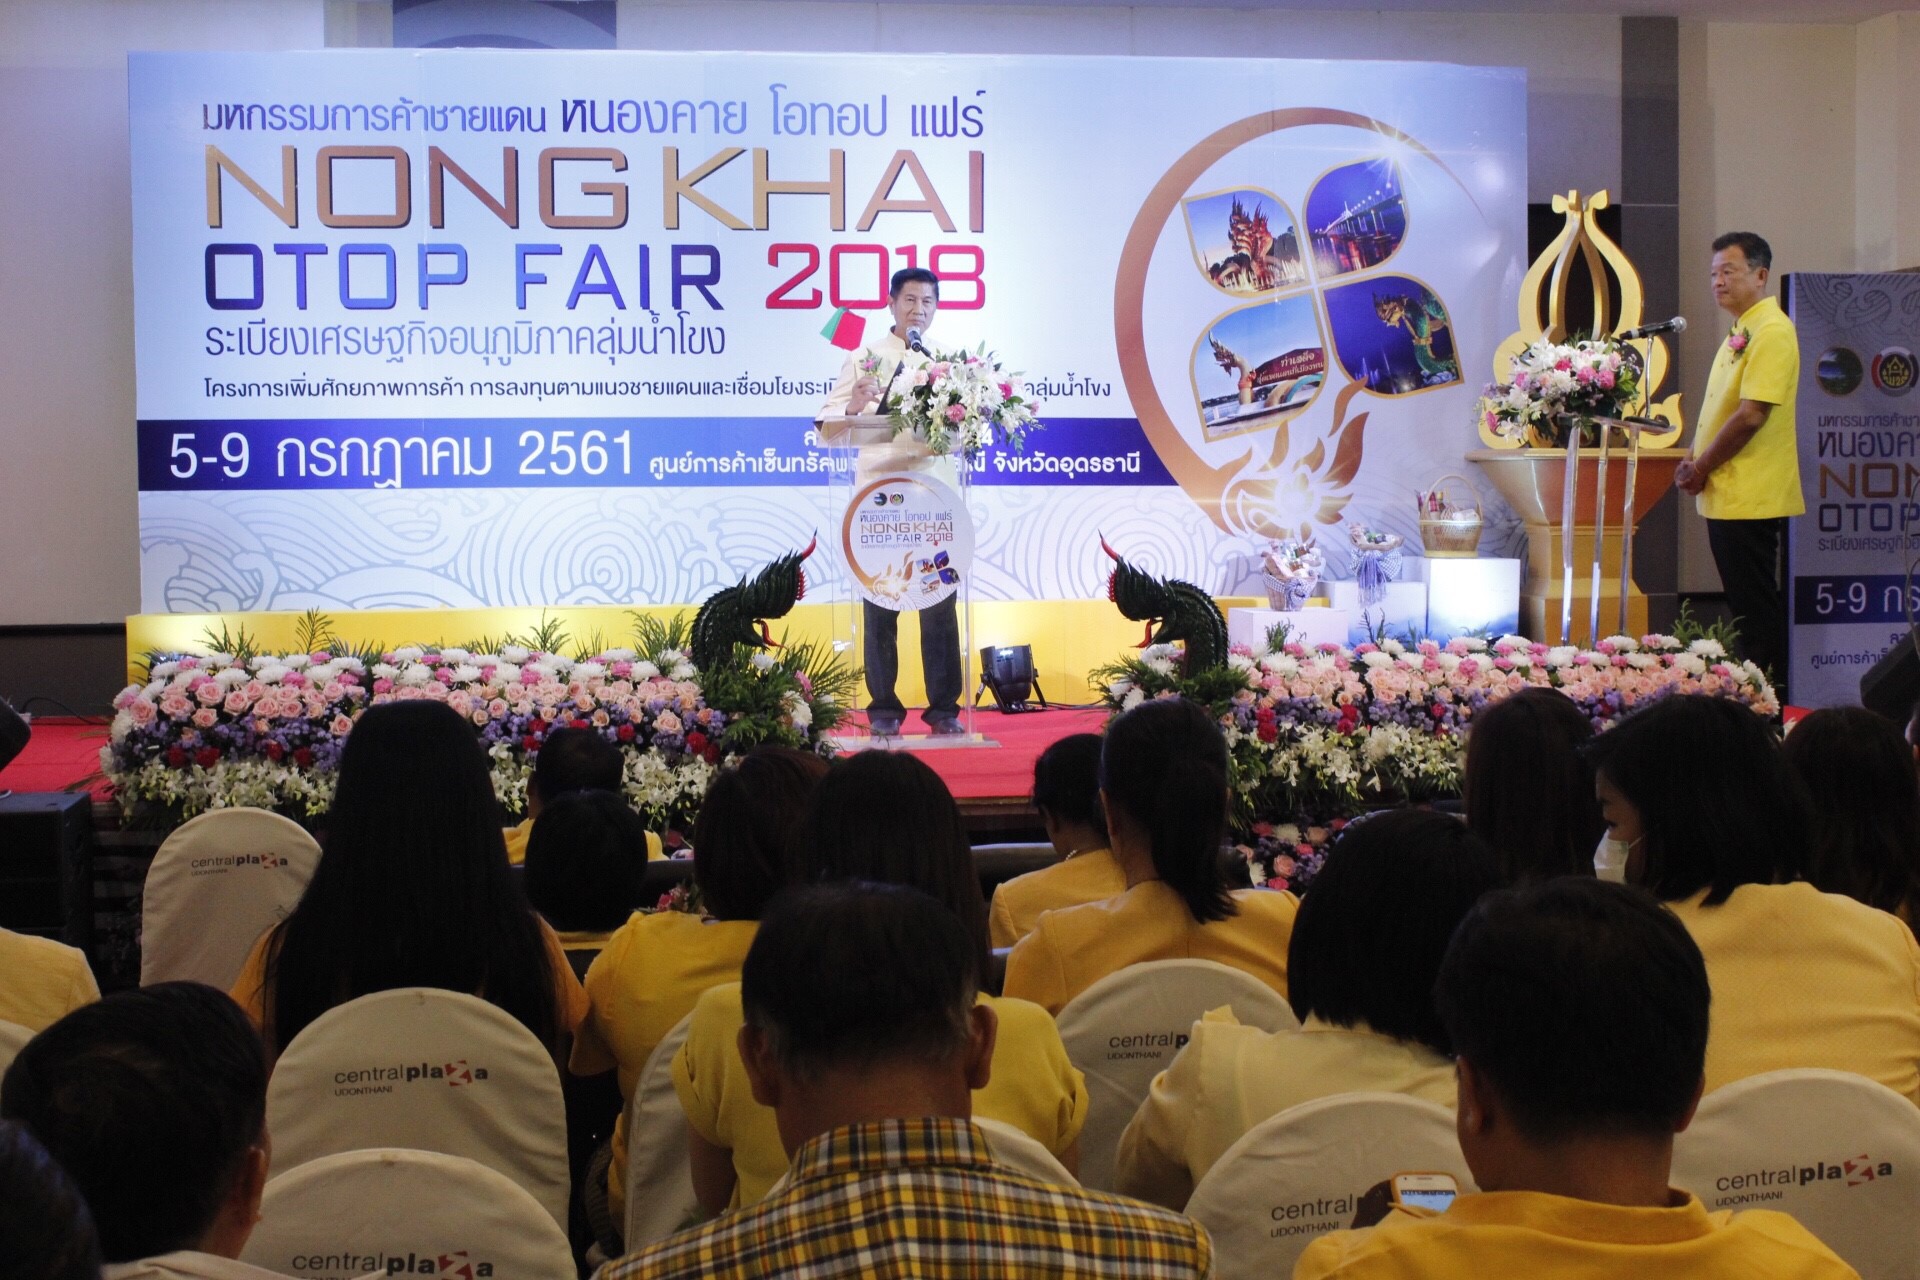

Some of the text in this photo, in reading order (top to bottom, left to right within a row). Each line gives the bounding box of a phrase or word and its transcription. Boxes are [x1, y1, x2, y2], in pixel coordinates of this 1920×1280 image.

[202, 83, 987, 138] มหกรรมการค้าชายแดน หนองคาย โอทอป แฟร์
[205, 144, 985, 234] NONG KHAI
[204, 243, 469, 311] OTOP
[514, 243, 726, 311] FAIR
[204, 311, 726, 366] ระเบียงเศรษฐกิจอนุภูมิภาคลุ่มน้ำโขง
[204, 372, 464, 398] โครงการเพิ่มศักยภาพการค้า
[169, 430, 632, 489] 5-9 กรกฎาคม 2561
[992, 450, 1141, 480] จังหวัดอุดรธานี
[860, 532, 954, 544] OTOP FAIR 2018
[861, 521, 953, 534] NONG KHAI
[1815, 582, 1867, 614] 5-9
[334, 1085, 393, 1097] UDONTHANI
[1715, 1191, 1783, 1207] UDONTHANI
[1270, 1221, 1340, 1238] UDONTHANI
